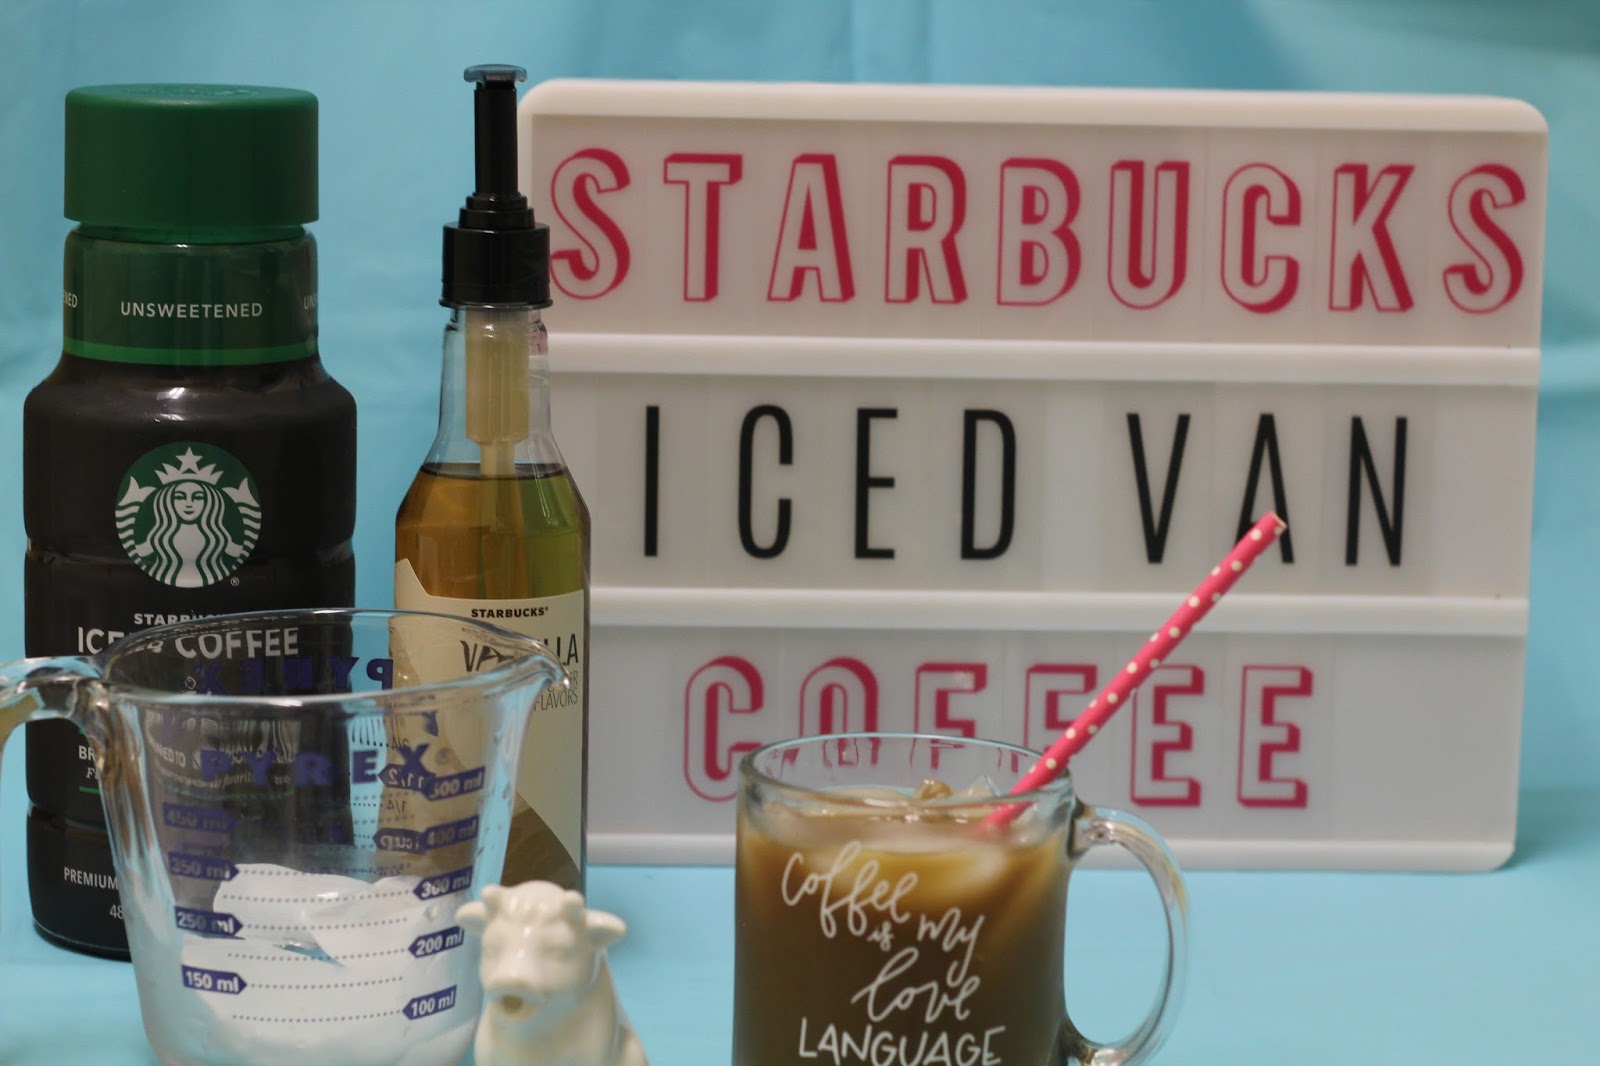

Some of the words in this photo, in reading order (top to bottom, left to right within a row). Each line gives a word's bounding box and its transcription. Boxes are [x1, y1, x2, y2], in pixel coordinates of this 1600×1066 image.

[549, 147, 1526, 315] STARBUCKS
[120, 301, 263, 319] UNSWEETENED
[642, 404, 1018, 561] ICED
[1126, 411, 1410, 568] VAN
[471, 606, 546, 618] STARBUCKS
[174, 627, 299, 660] COFFEE
[684, 655, 1314, 810] COFFEE
[199, 743, 430, 787] PYREX
[63, 866, 119, 891] PREMIUM
[420, 878, 449, 899] 300
[451, 872, 471, 890] ml
[176, 910, 205, 930] 250
[211, 917, 234, 935] ml
[415, 935, 443, 956] 200
[444, 928, 463, 947] ml
[185, 970, 213, 989] 150
[216, 974, 240, 993] ml
[850, 946, 981, 1024] love
[410, 997, 436, 1017] 100
[437, 990, 455, 1009] ml
[799, 1016, 1006, 1066] LANGUAGE
